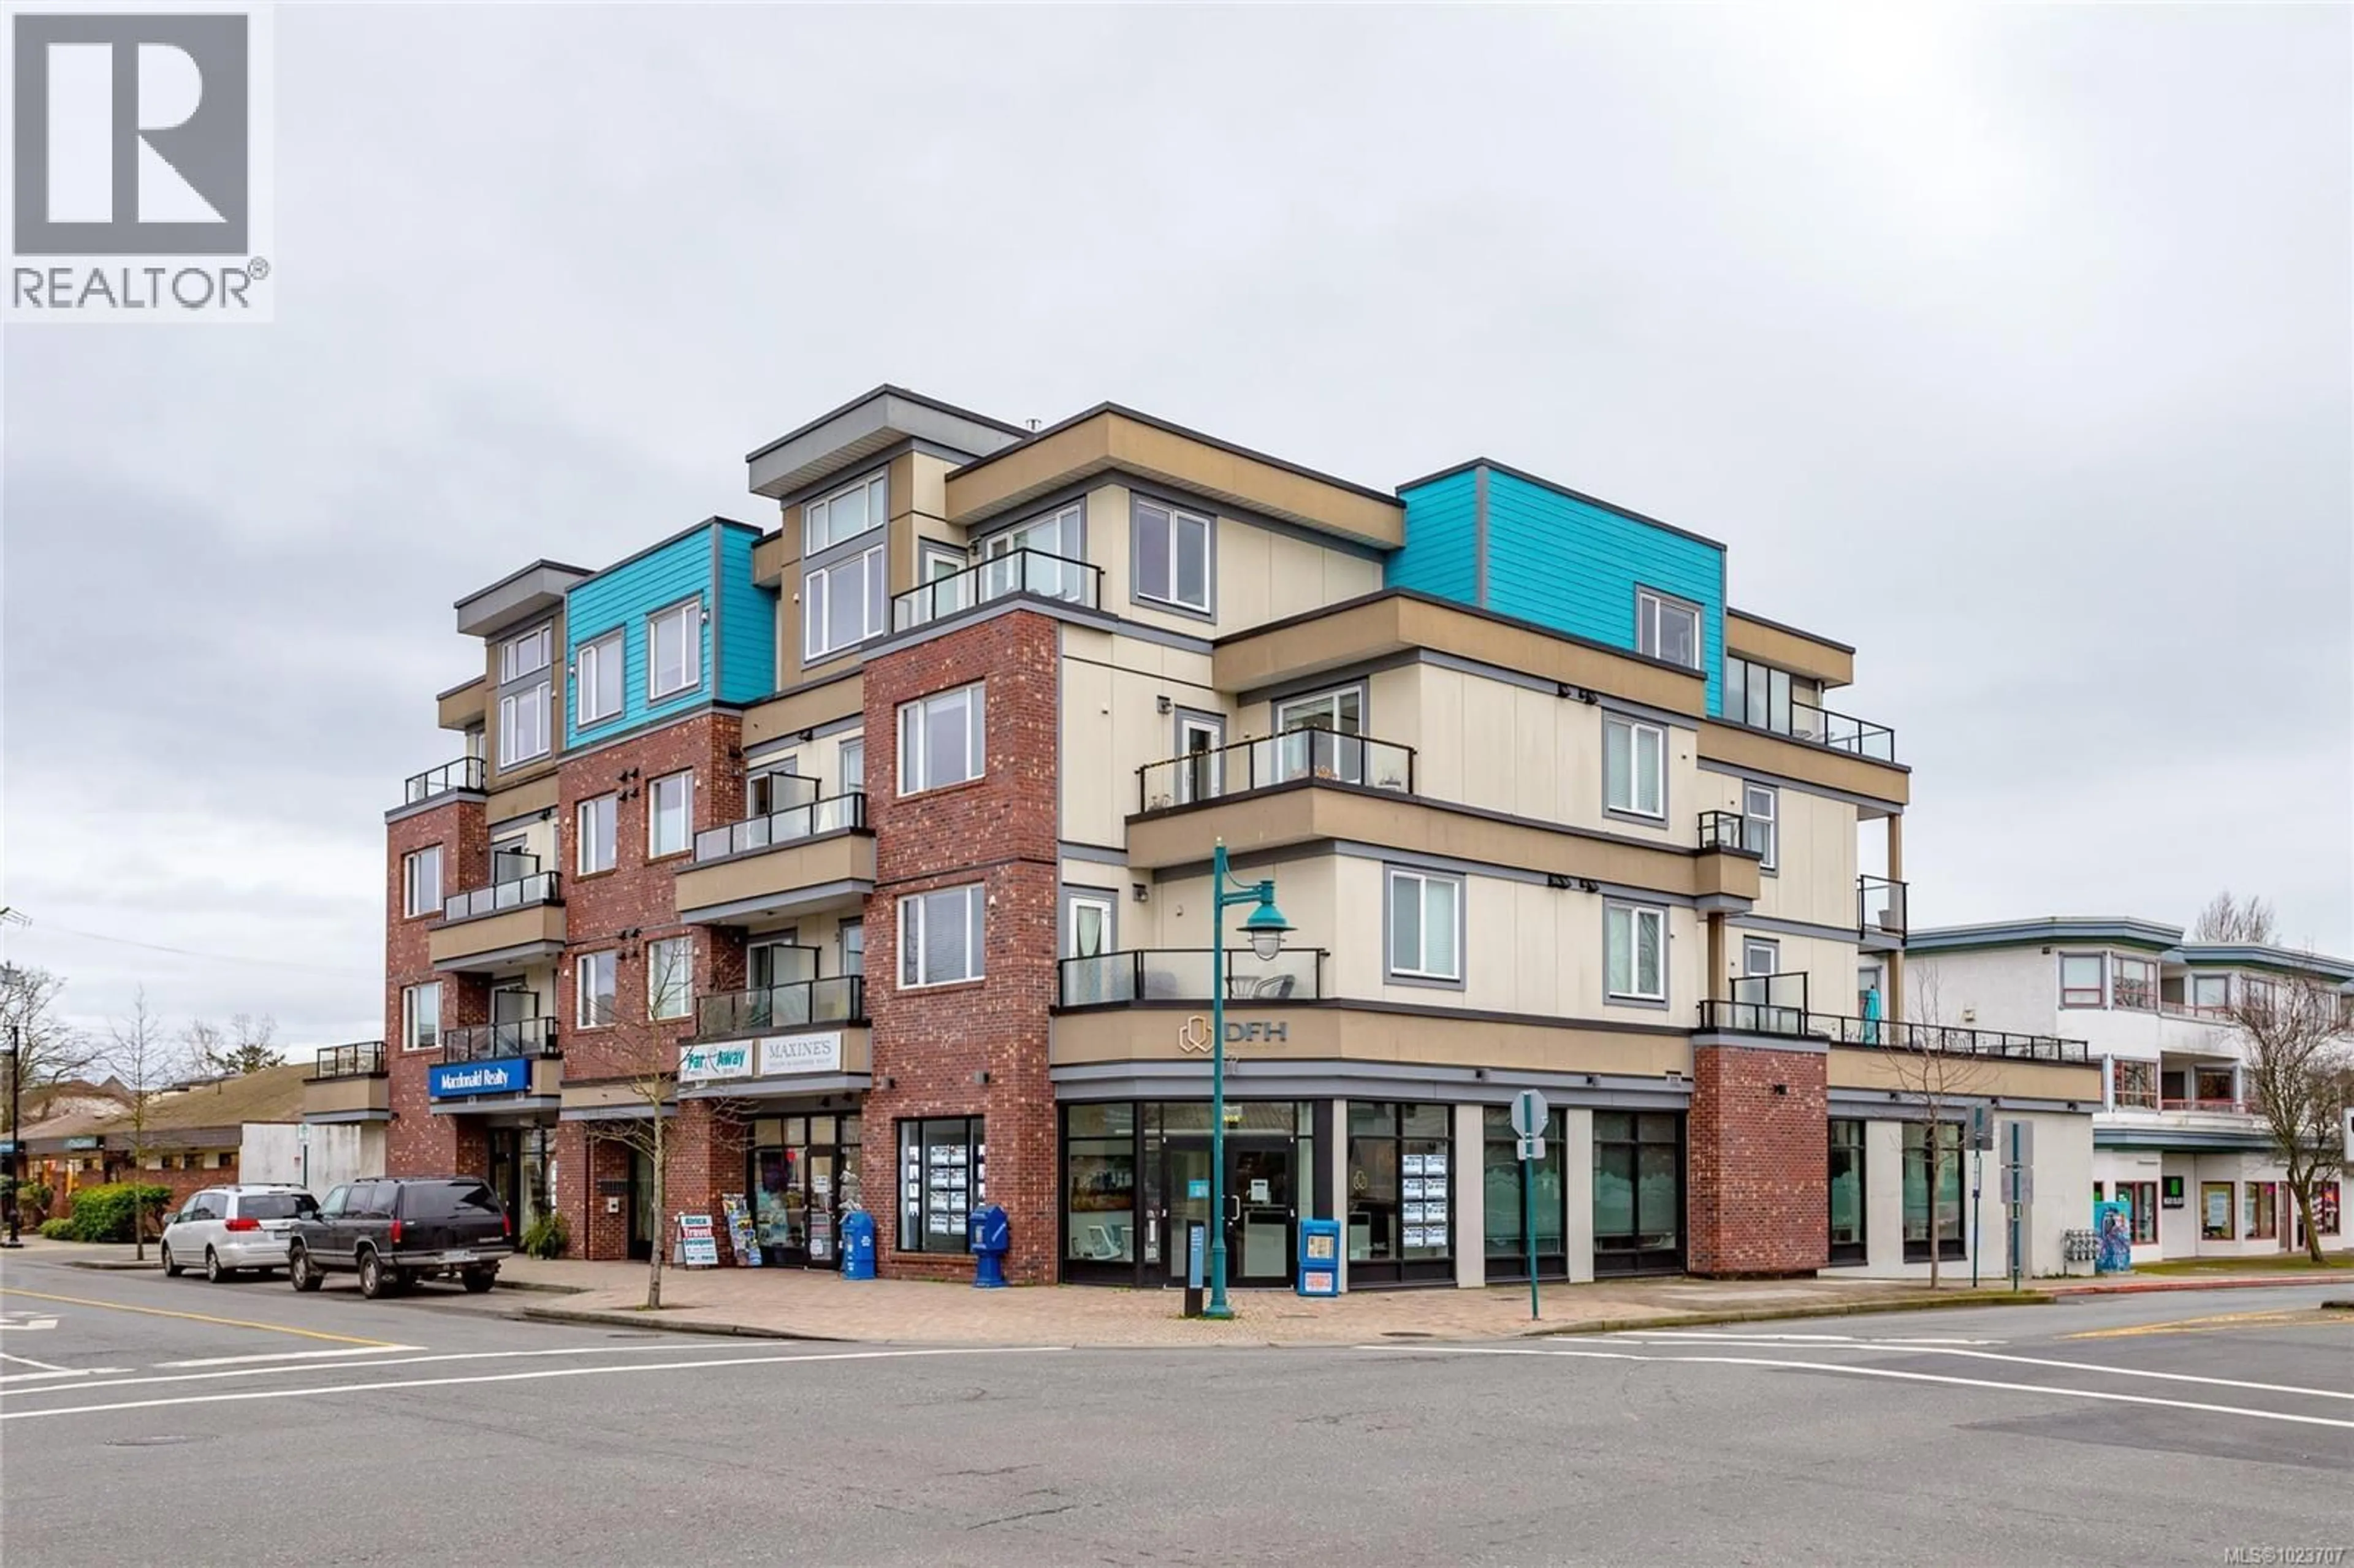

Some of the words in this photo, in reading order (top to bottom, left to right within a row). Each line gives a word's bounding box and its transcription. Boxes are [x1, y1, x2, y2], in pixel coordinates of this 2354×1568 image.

[1224, 1021, 1287, 1042] DFH
[716, 1049, 746, 1068] Away
[484, 1068, 508, 1087] Realty
